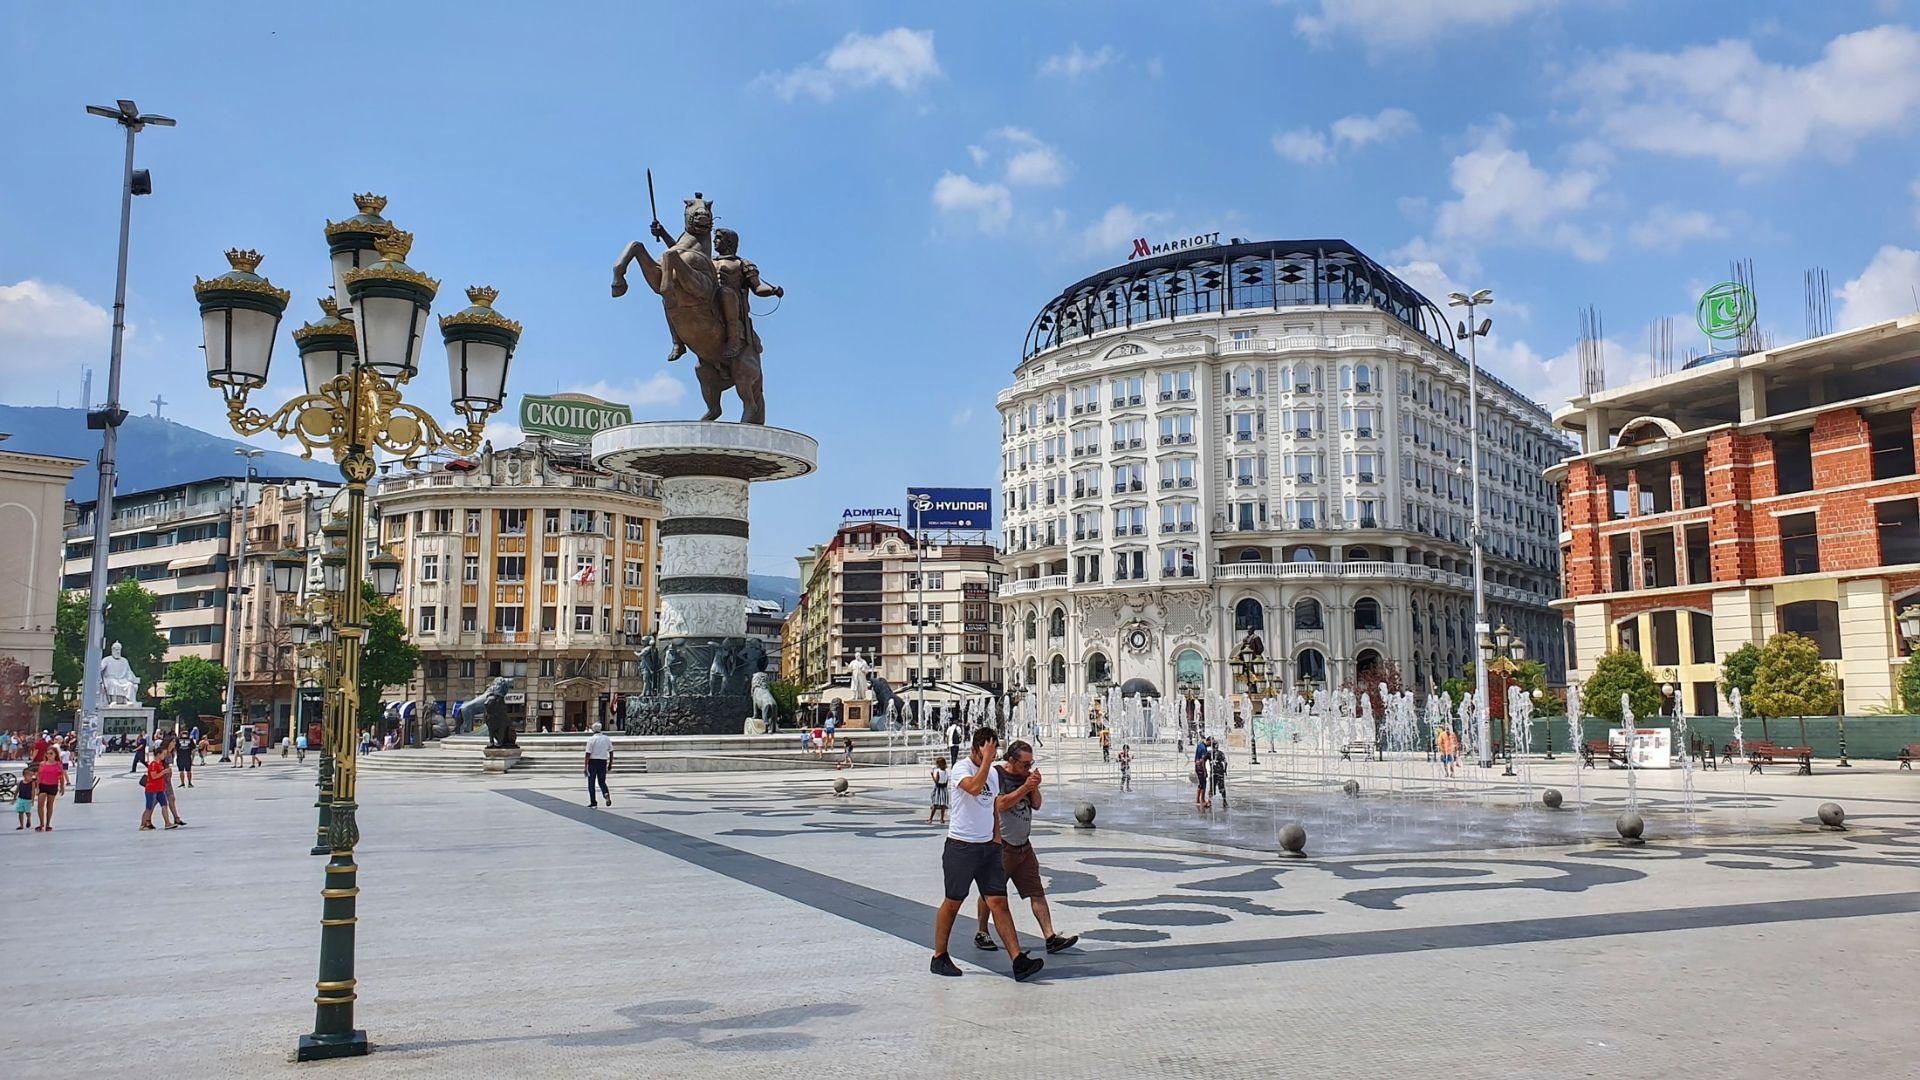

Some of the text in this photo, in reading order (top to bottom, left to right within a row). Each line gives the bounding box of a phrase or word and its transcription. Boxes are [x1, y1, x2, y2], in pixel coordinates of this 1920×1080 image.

[1152, 232, 1220, 254] MARRIOTT
[527, 402, 627, 430] СКОПСКО
[842, 507, 902, 518] ADMIRAL
[936, 501, 988, 511] HYUNDAI
